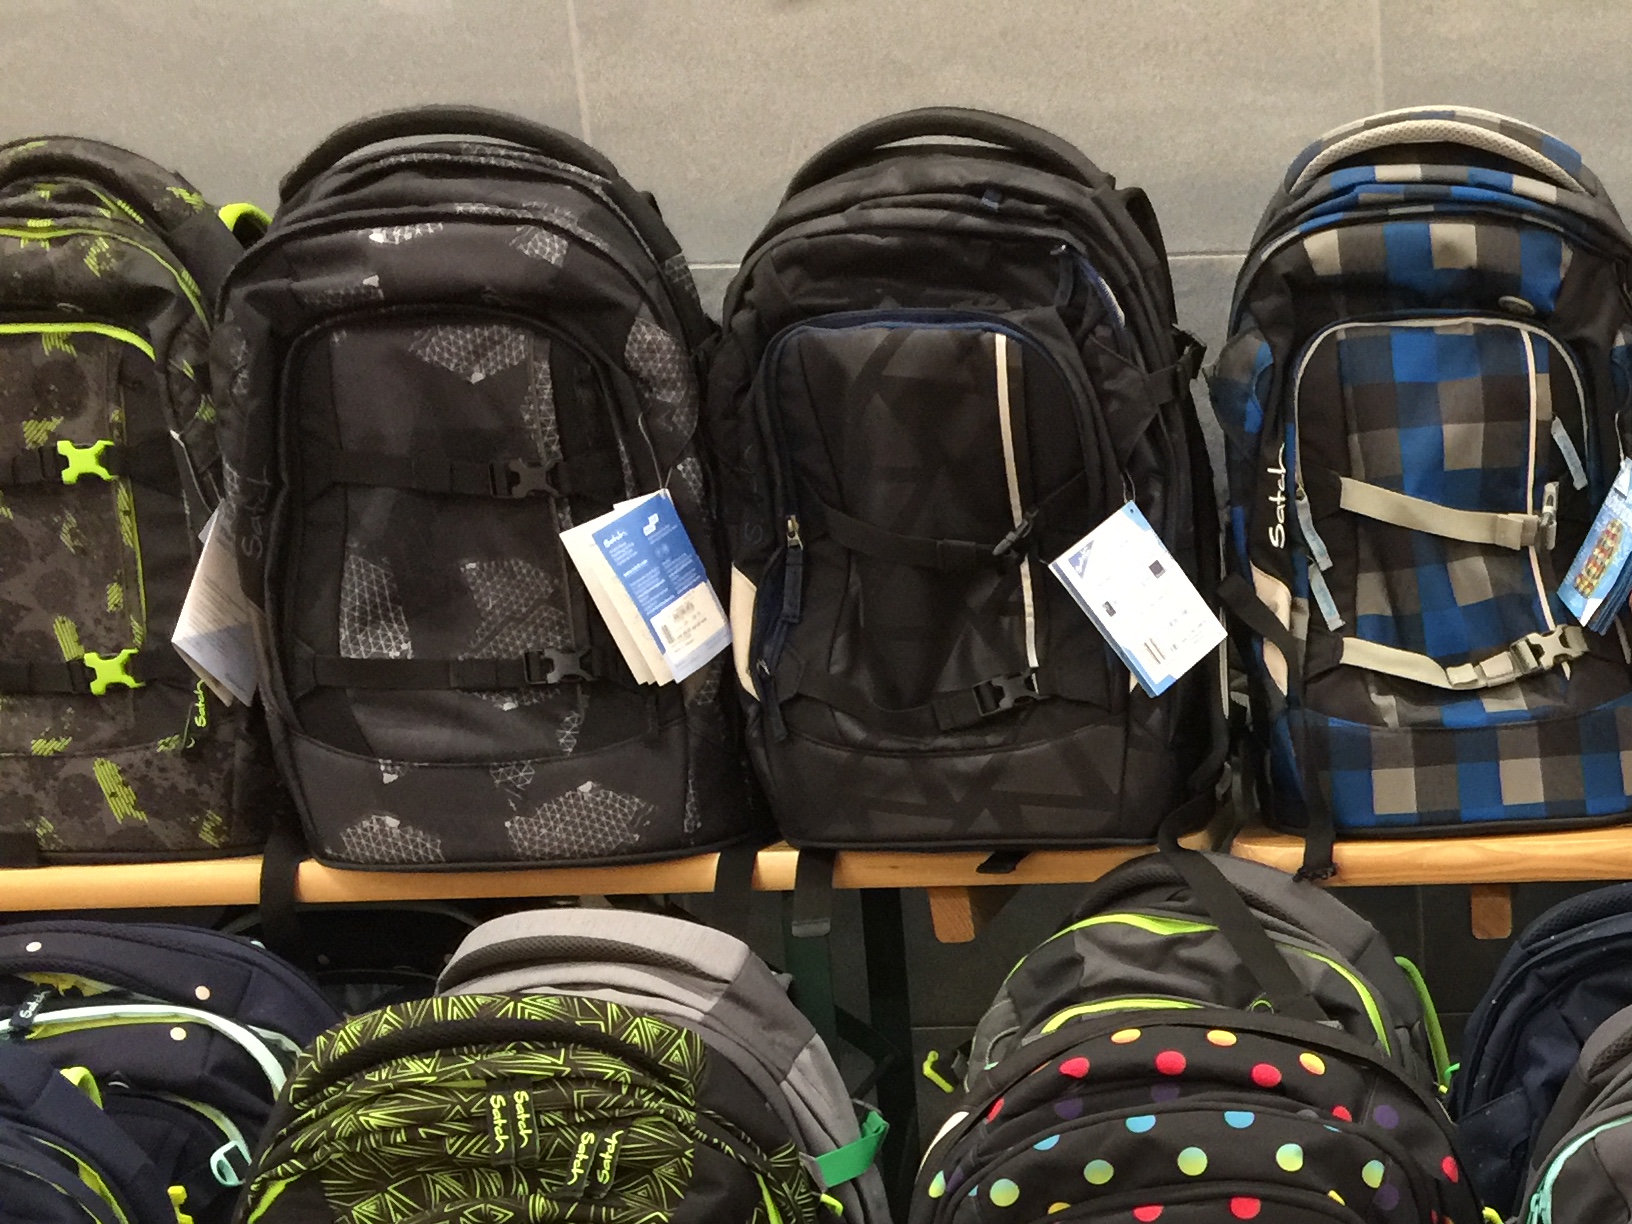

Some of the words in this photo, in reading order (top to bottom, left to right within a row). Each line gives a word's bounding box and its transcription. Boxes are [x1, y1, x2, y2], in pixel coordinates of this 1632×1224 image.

[1266, 442, 1286, 549] Satch
[19, 991, 51, 1019] Satch
[489, 1094, 510, 1154] Satch
[513, 1090, 533, 1149] Satch
[567, 1131, 596, 1186] Satch
[597, 1130, 625, 1185] Satch
